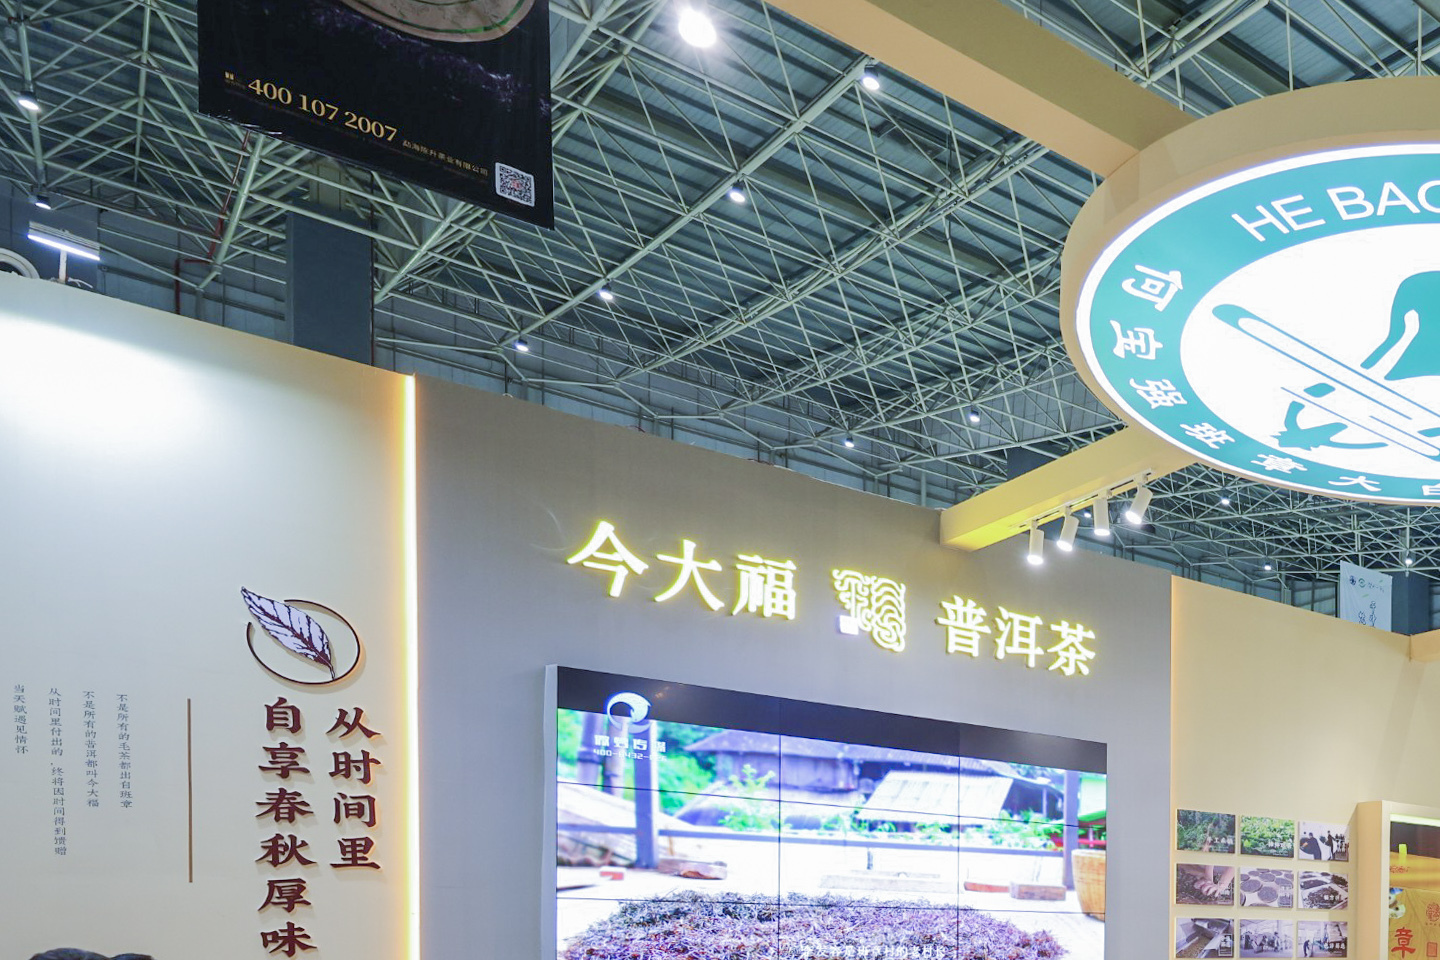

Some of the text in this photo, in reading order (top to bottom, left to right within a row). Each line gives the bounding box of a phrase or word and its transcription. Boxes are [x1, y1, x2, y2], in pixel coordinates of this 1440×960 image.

[248, 79, 292, 105] 400
[298, 94, 339, 121] 107
[344, 111, 397, 141] 2007
[1231, 194, 1326, 241] HE
[567, 520, 798, 620] 今大福
[936, 595, 1097, 677] 普洱茶
[255, 696, 318, 958] 自享春秋厚味
[325, 706, 382, 870] 从时间里
